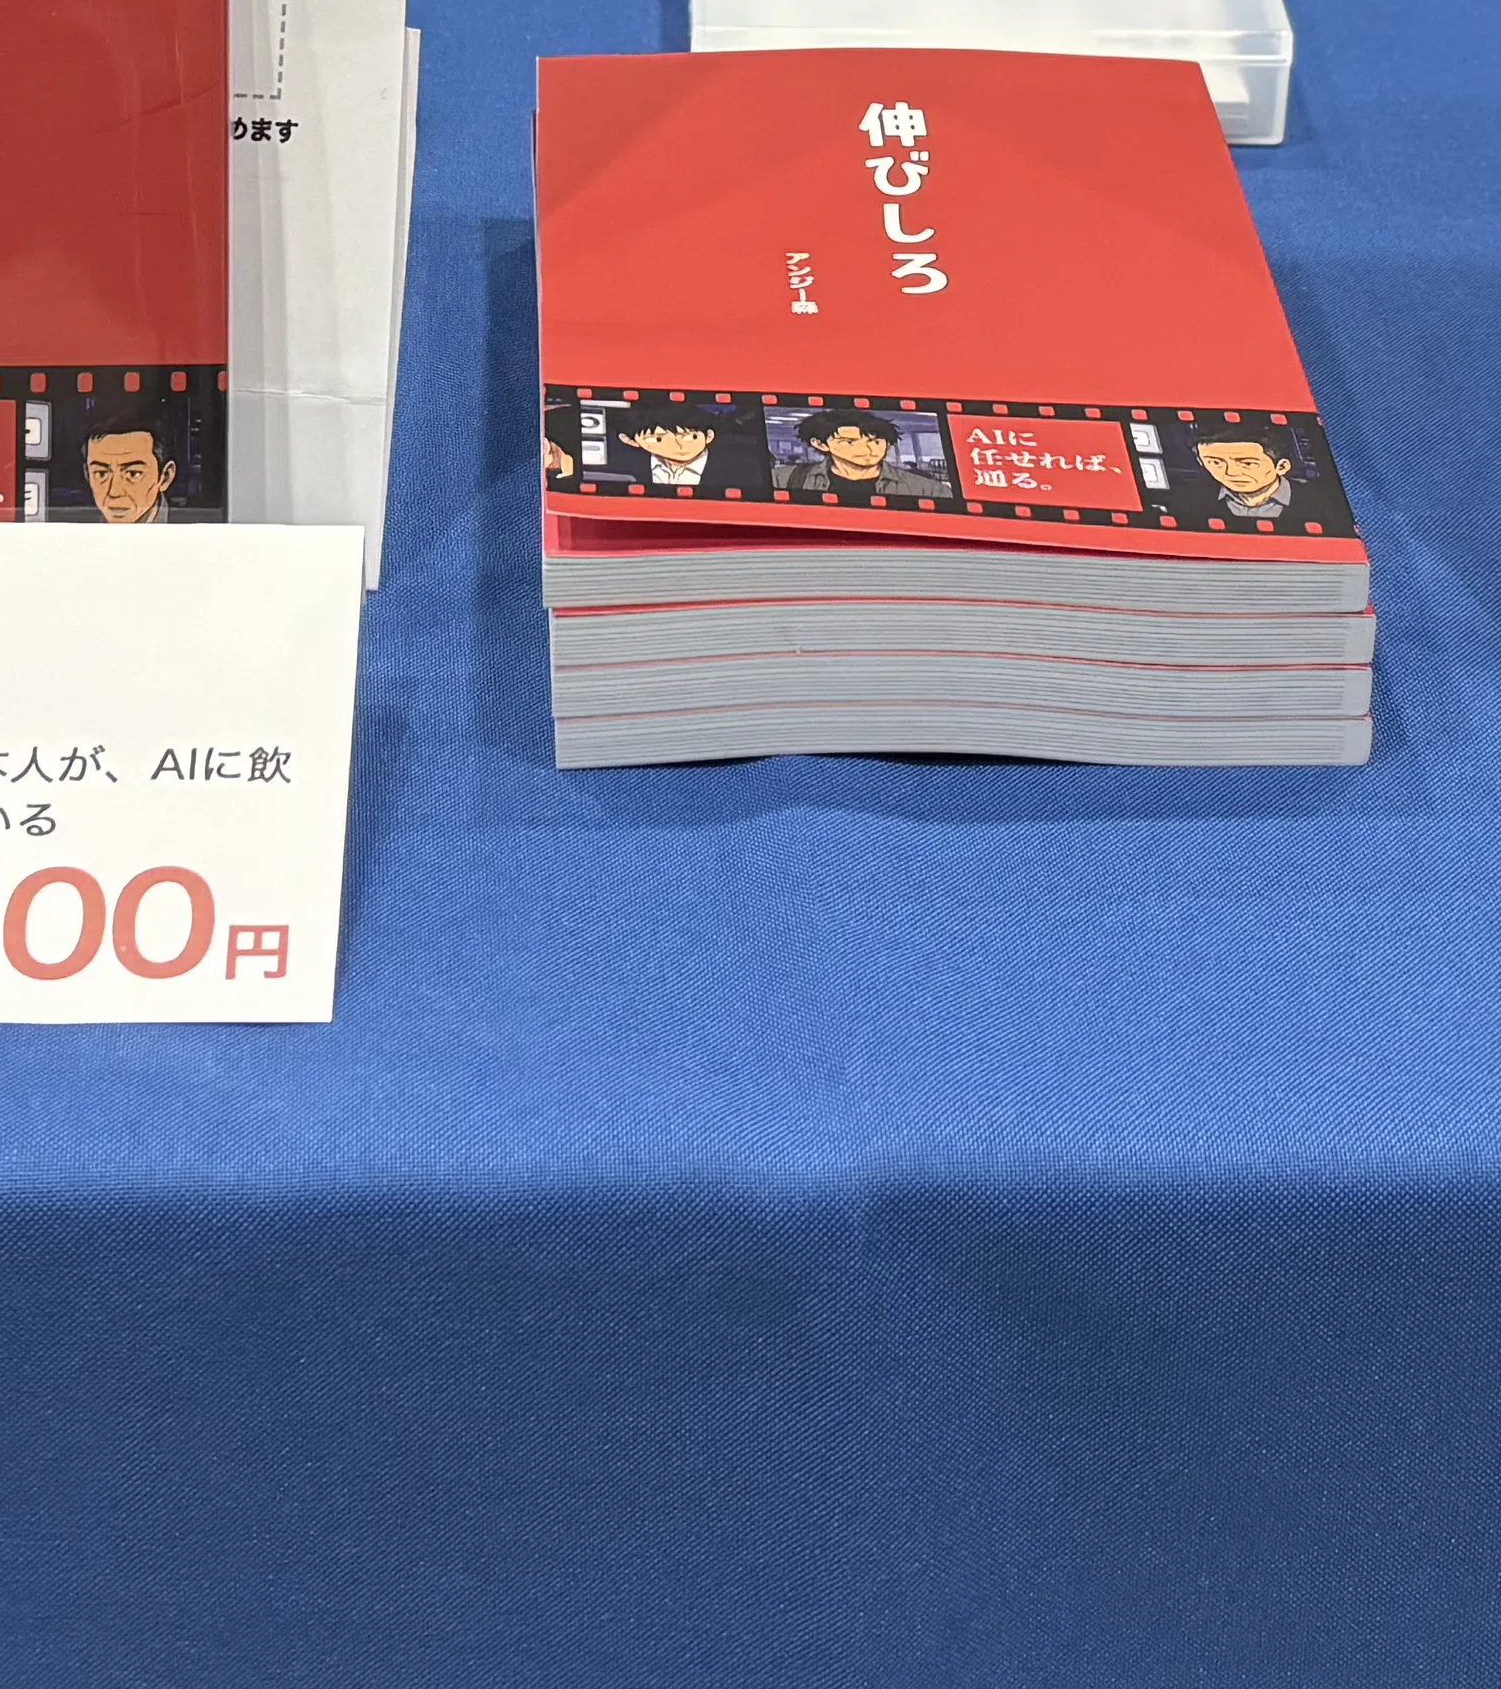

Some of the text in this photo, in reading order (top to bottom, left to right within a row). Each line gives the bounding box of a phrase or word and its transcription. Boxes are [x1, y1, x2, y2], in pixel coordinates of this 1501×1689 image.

[859, 101, 949, 295] 伸びしろ
[967, 429, 1037, 446] AIに
[971, 448, 1121, 473] 任せれば、
